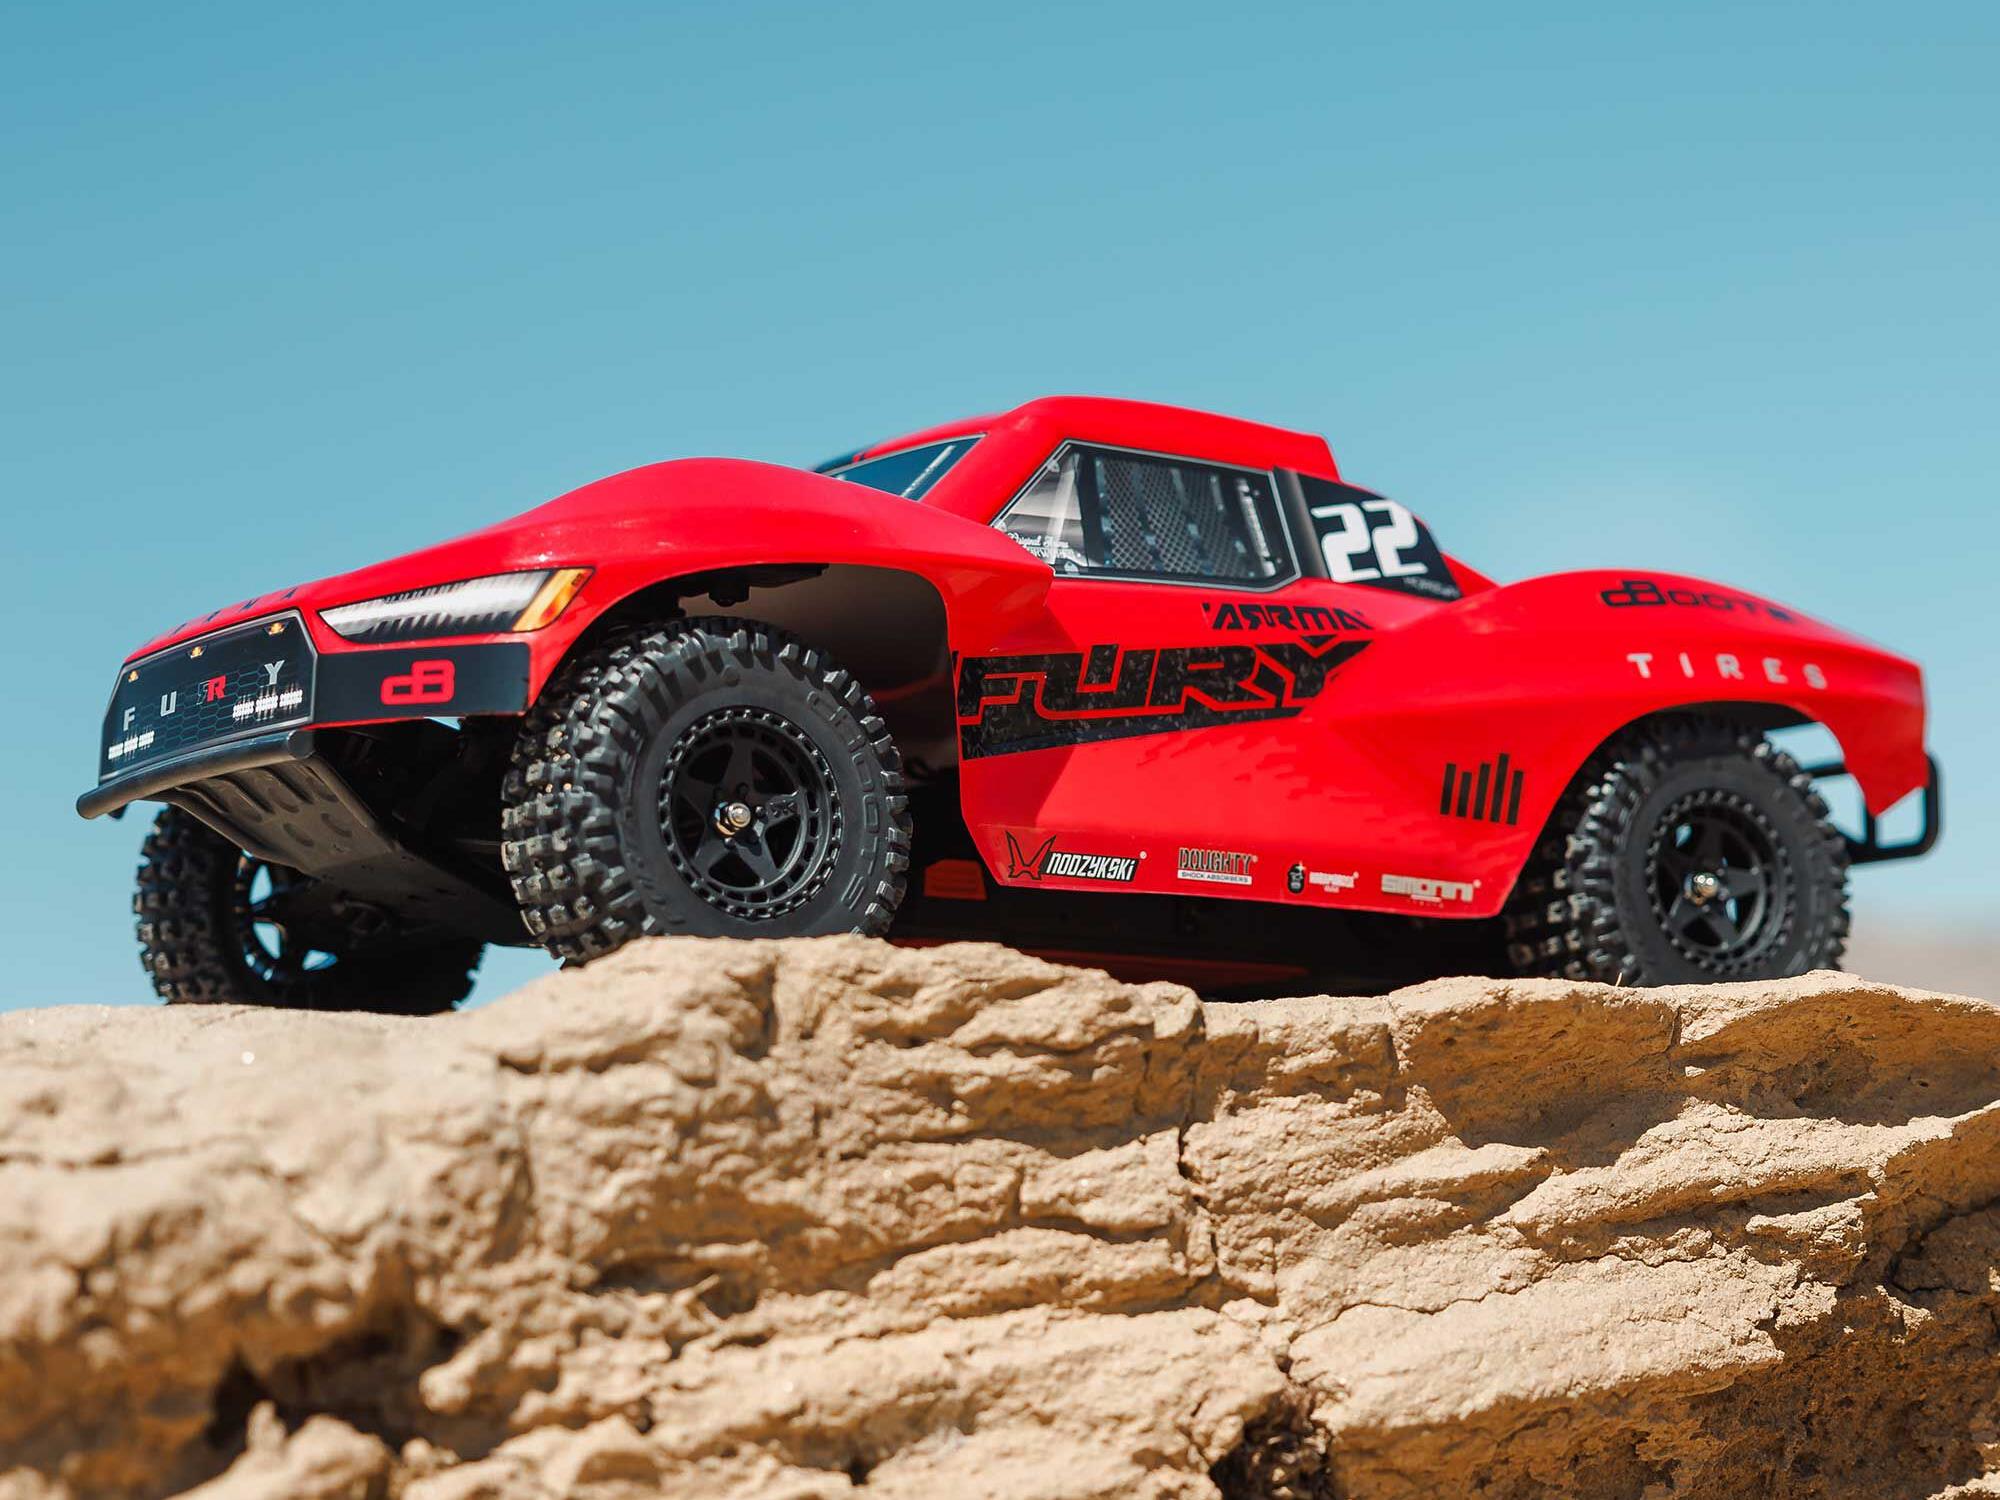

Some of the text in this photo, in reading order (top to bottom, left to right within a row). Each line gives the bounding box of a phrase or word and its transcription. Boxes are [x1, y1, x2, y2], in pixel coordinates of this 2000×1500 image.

[1310, 500, 1428, 583] 22
[380, 660, 455, 705] dB
[955, 636, 1373, 722] FURY
[1626, 653, 1828, 689] TIRES
[1178, 847, 1252, 875] DOUGHTY
